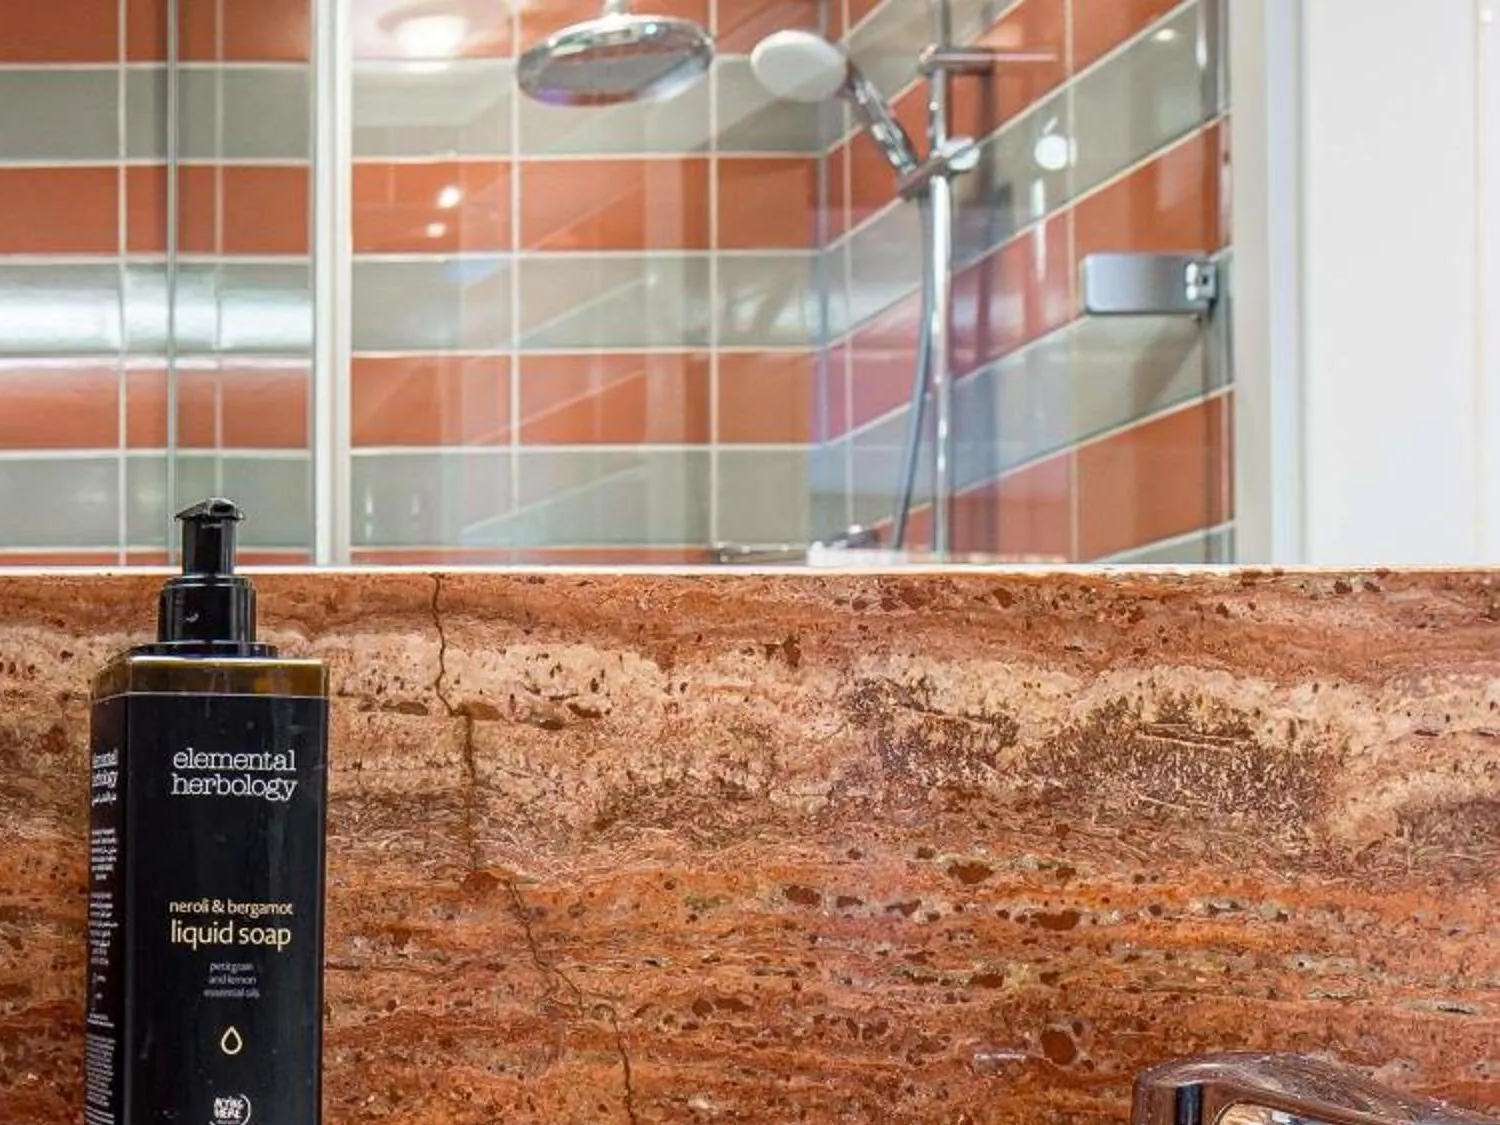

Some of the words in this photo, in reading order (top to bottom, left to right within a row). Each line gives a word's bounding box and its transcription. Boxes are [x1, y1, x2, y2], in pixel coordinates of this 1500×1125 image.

[173, 748, 297, 771] elemental
[170, 773, 298, 801] herbology
[169, 898, 209, 914] neroli
[211, 900, 225, 914] &
[228, 899, 293, 919] bergamot
[171, 919, 233, 950] liquid
[238, 926, 291, 952] soap
